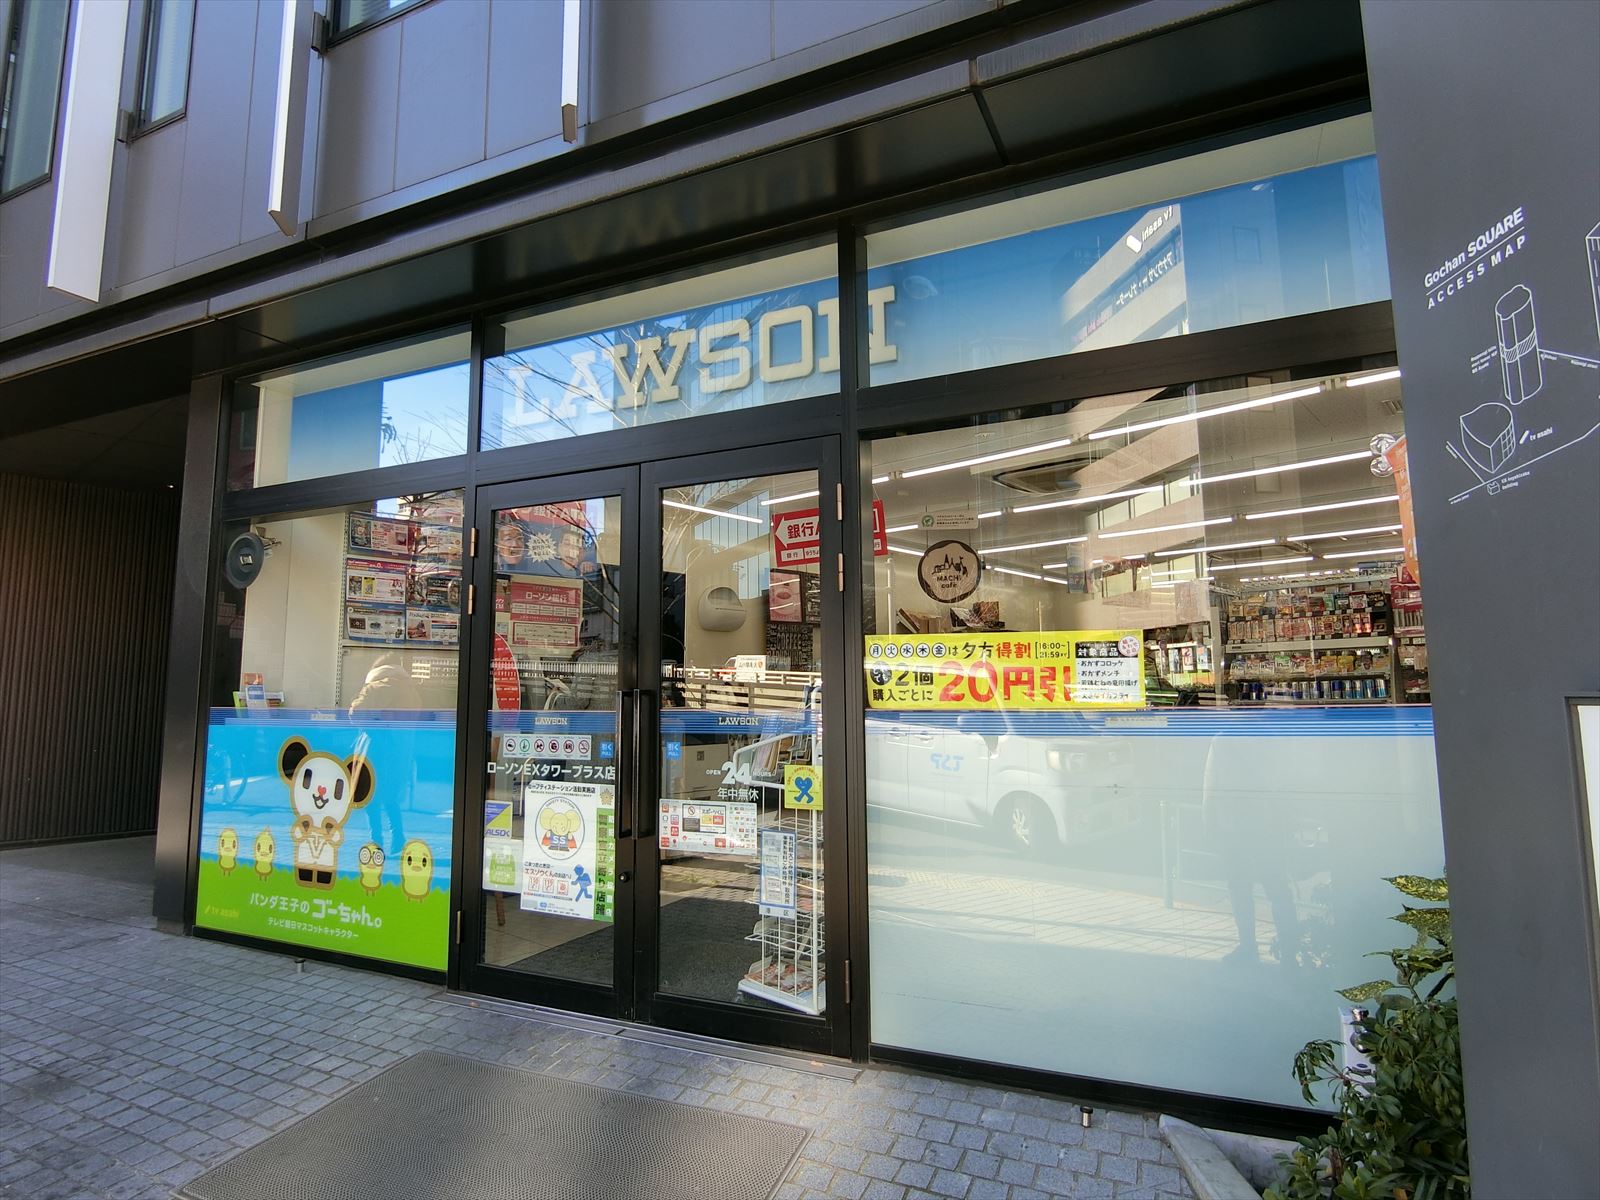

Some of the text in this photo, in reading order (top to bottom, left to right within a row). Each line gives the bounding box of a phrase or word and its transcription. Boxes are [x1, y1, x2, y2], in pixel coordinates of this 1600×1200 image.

[1423, 206, 1525, 289] Gochan SQUARE
[1427, 234, 1527, 311] ACCESS MAP
[1077, 647, 1119, 657] 対象商品
[872, 688, 933, 702] 購入ごとに
[534, 717, 568, 726] LAWSON
[718, 717, 759, 726] LAWSON
[487, 761, 616, 781] ローソンEXタワープラス店
[721, 761, 751, 785] 24
[717, 787, 760, 802] 年中無休
[484, 828, 510, 838] ALSOK
[551, 835, 566, 845] SS
[266, 916, 360, 939] テレビ朝日マスコットキャラクター
